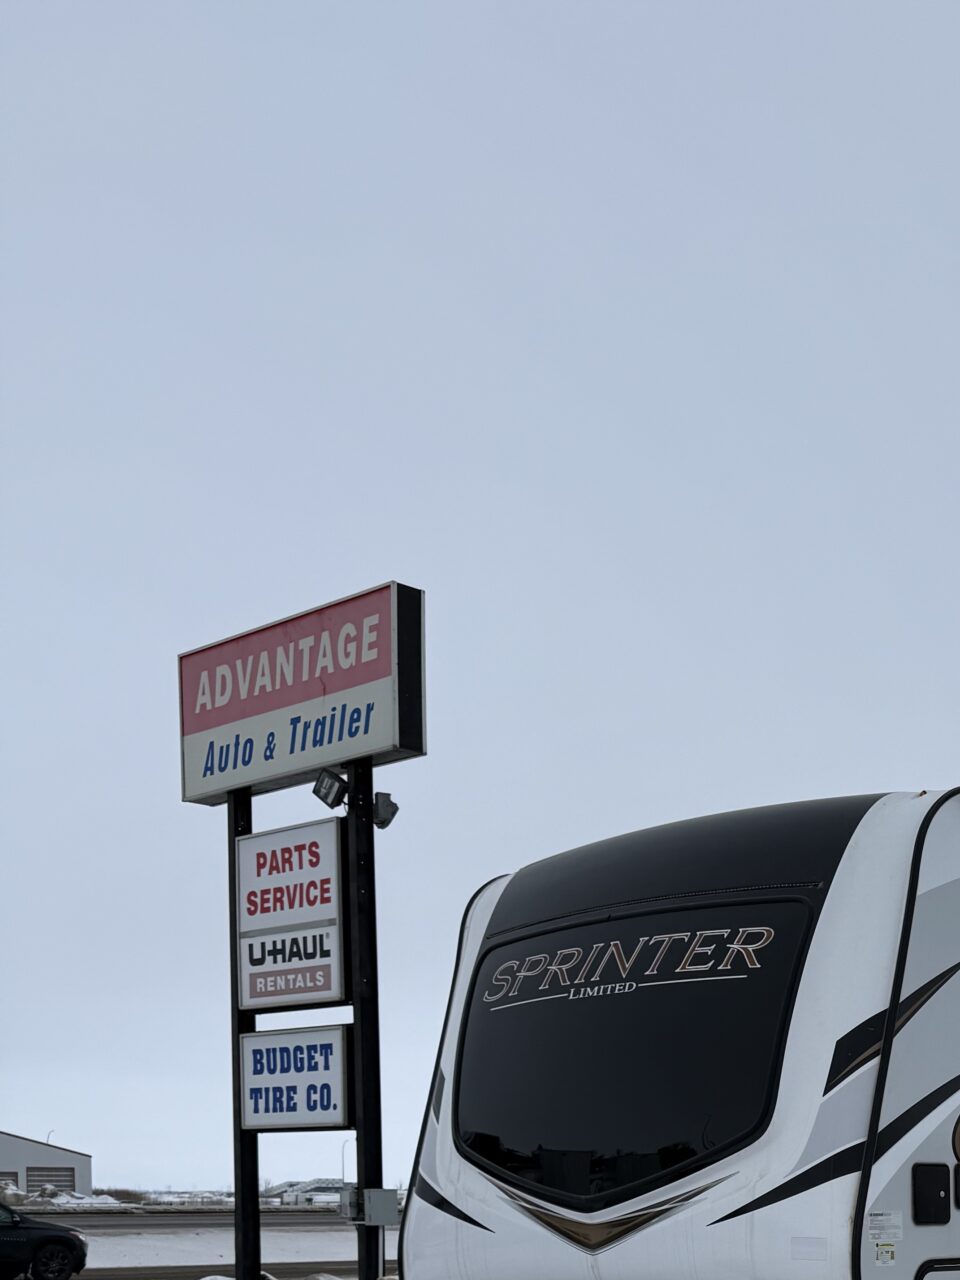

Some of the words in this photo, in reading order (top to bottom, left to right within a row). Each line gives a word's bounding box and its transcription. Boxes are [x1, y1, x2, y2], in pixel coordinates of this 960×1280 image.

[194, 613, 380, 714] ADVANTAGE
[202, 733, 254, 778] Auto
[263, 731, 277, 761] &
[289, 701, 375, 755] Trailer
[256, 841, 320, 878] PARTS
[246, 878, 332, 917] SERVICE
[256, 970, 324, 993] RENTALS
[482, 926, 775, 1002] SPRINTER
[568, 981, 637, 1000] LIMITED
[252, 1042, 334, 1076] BUDGET
[250, 1085, 298, 1114] TIRE
[306, 1082, 338, 1113] CO.
